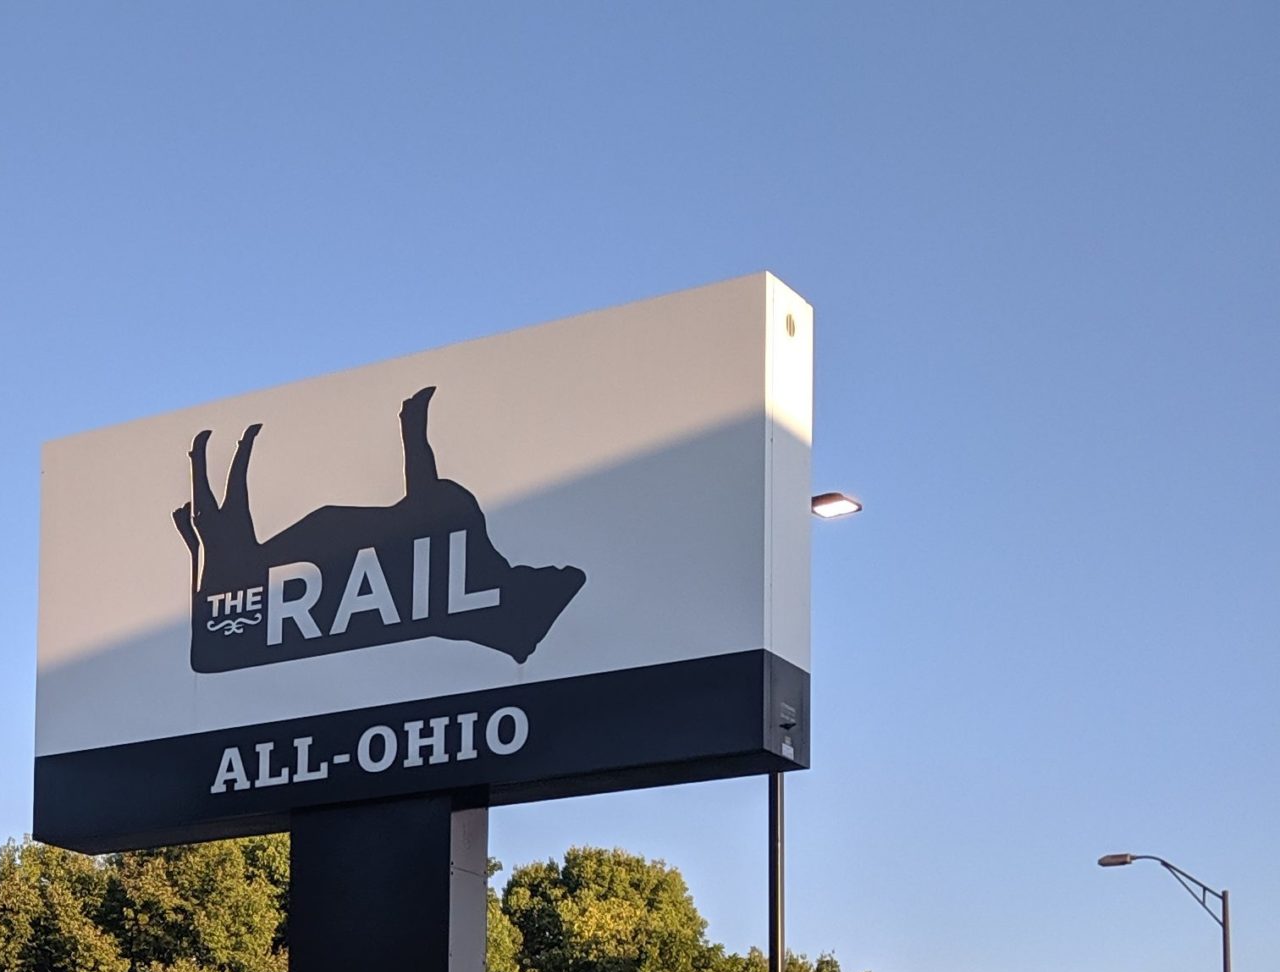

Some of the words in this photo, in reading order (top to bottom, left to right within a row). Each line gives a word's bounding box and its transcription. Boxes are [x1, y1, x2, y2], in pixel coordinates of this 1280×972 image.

[206, 586, 263, 618] THE
[266, 529, 501, 646] RAIL
[209, 706, 530, 794] ALL-OHIO
